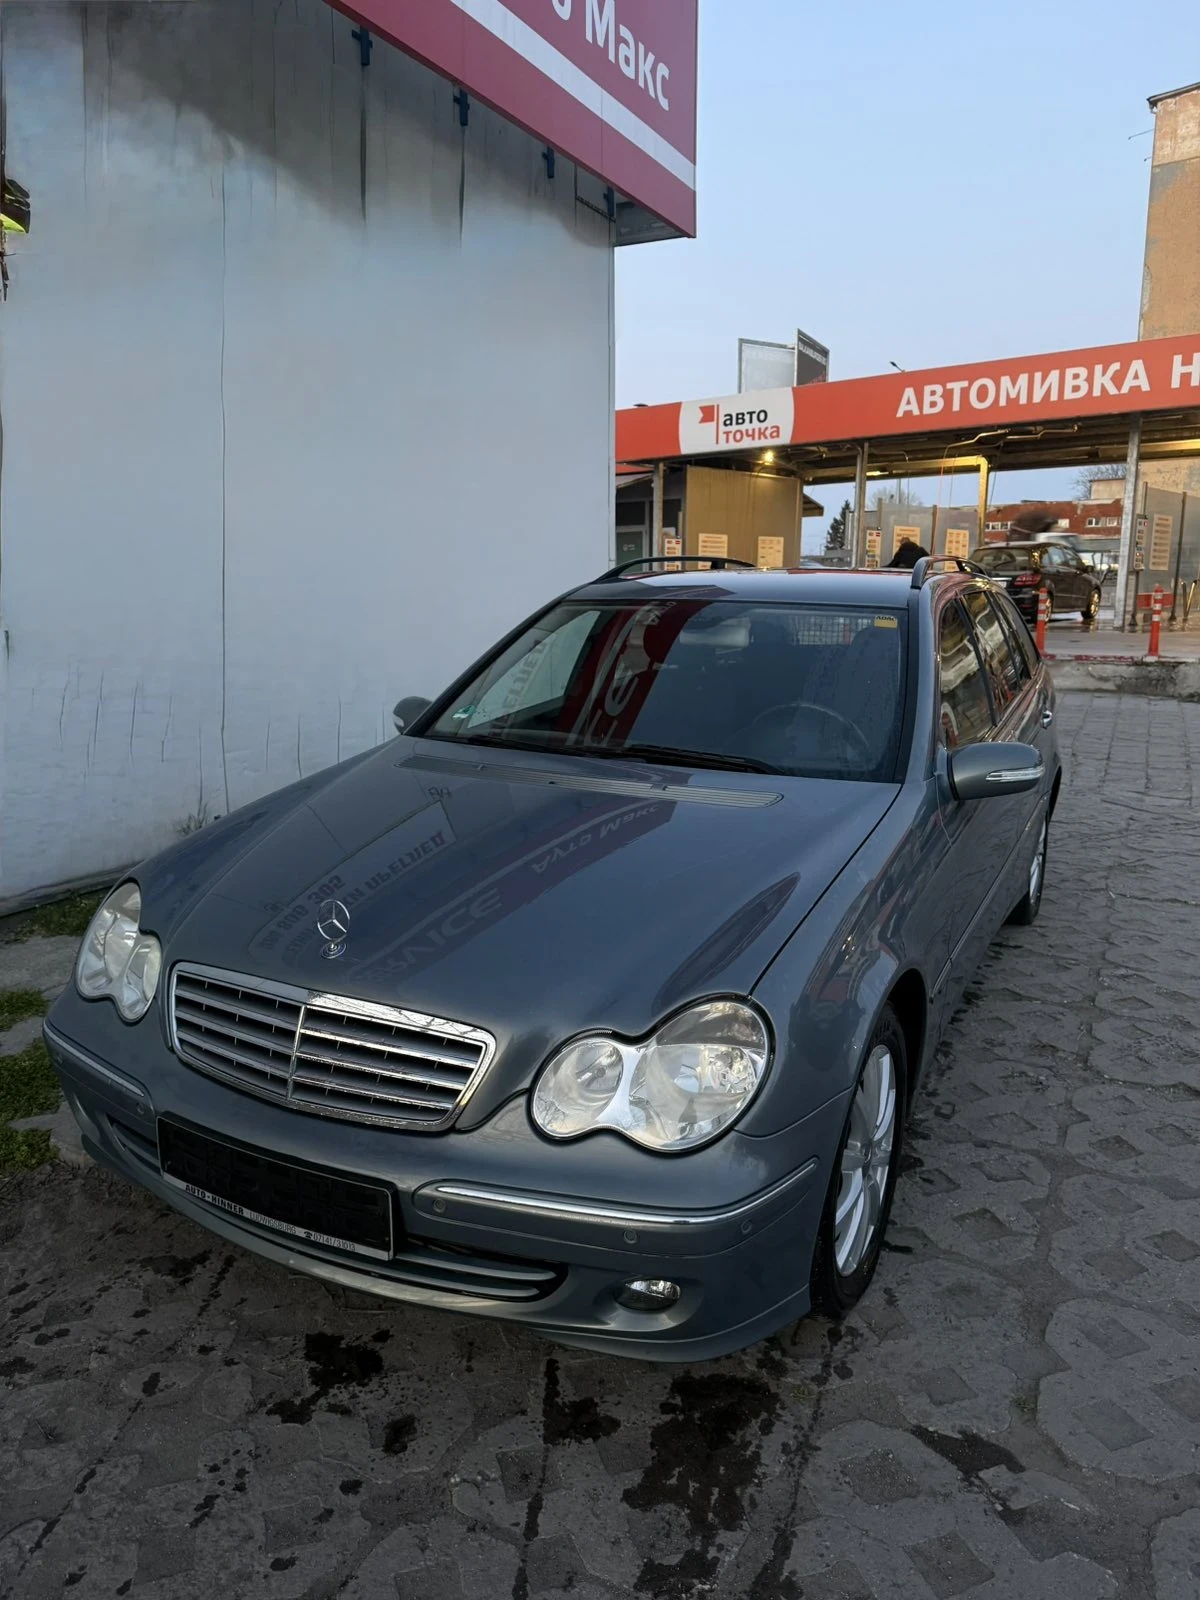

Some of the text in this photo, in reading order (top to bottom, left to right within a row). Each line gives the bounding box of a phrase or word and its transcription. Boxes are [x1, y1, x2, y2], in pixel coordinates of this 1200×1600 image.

[586, 0, 670, 111] Макс
[896, 359, 1150, 418] АВТОМИВКА
[723, 409, 768, 427] авто
[723, 425, 781, 444] точка
